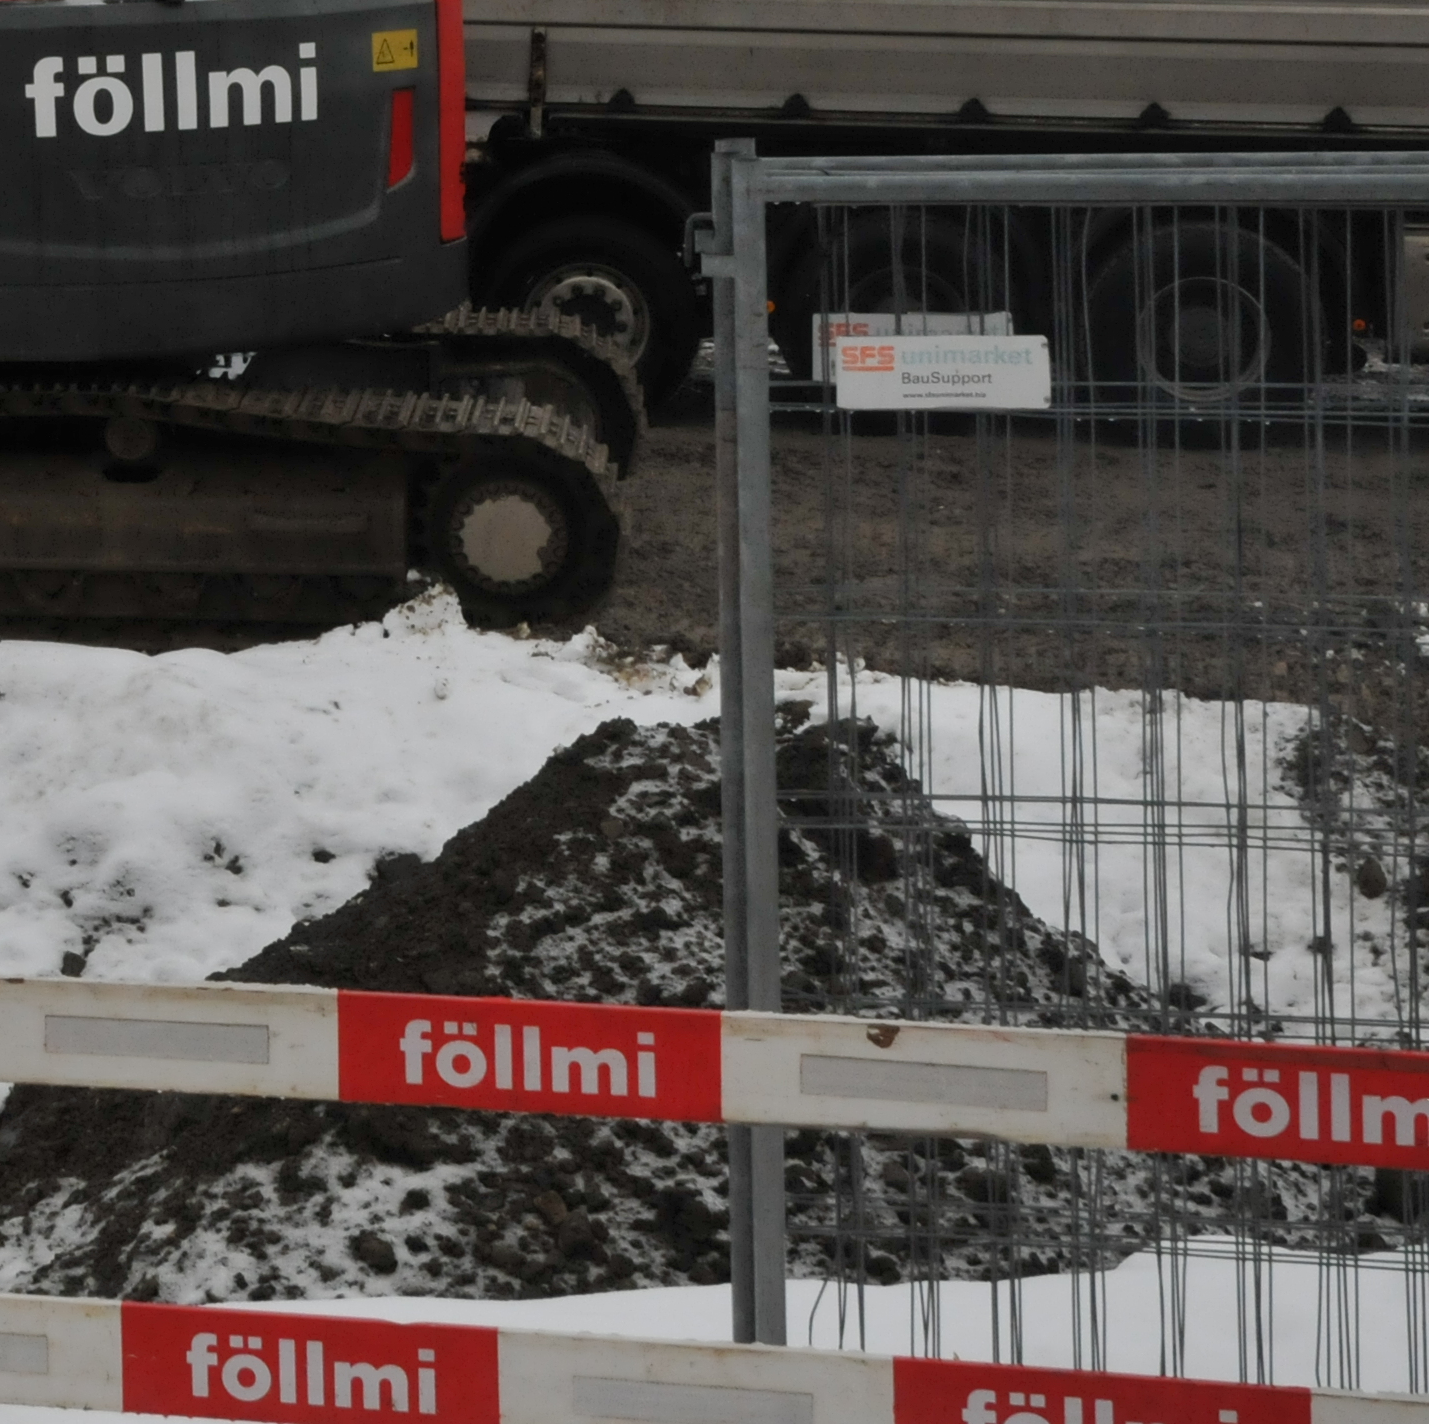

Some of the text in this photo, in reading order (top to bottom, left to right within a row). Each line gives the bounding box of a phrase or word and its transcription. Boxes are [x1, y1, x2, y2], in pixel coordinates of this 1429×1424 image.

[25, 42, 319, 138] föllmi
[842, 345, 1033, 365] SFS unimarket
[901, 371, 992, 386] BauSupport
[400, 1019, 656, 1098] föllmi
[186, 1332, 437, 1416] föllmi
